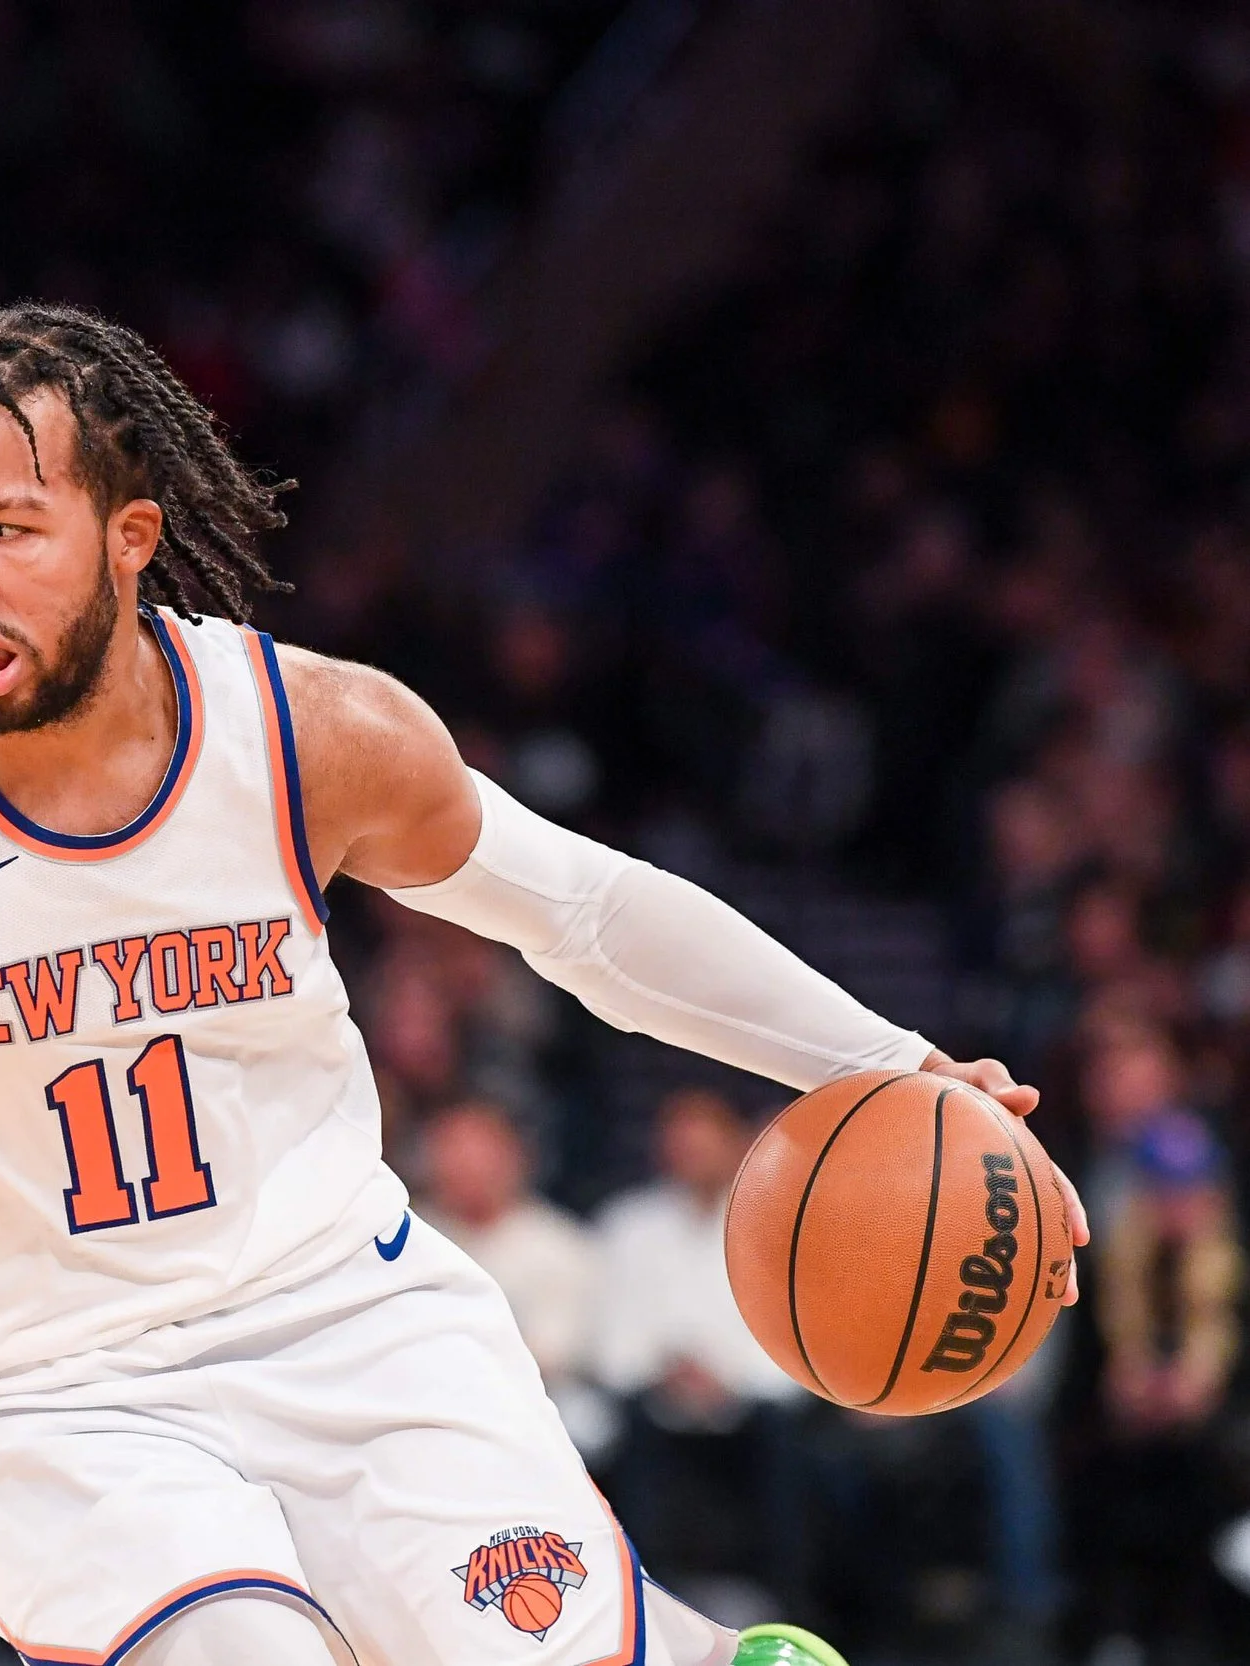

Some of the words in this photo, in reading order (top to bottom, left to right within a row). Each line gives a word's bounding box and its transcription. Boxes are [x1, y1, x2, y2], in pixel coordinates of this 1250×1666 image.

[90, 915, 293, 1024] YORK
[44, 1033, 218, 1235] 11
[920, 1152, 1019, 1373] Wilson
[464, 1531, 588, 1609] KNICKS
[489, 1530, 511, 1547] NEW
[512, 1525, 541, 1538] YORK
